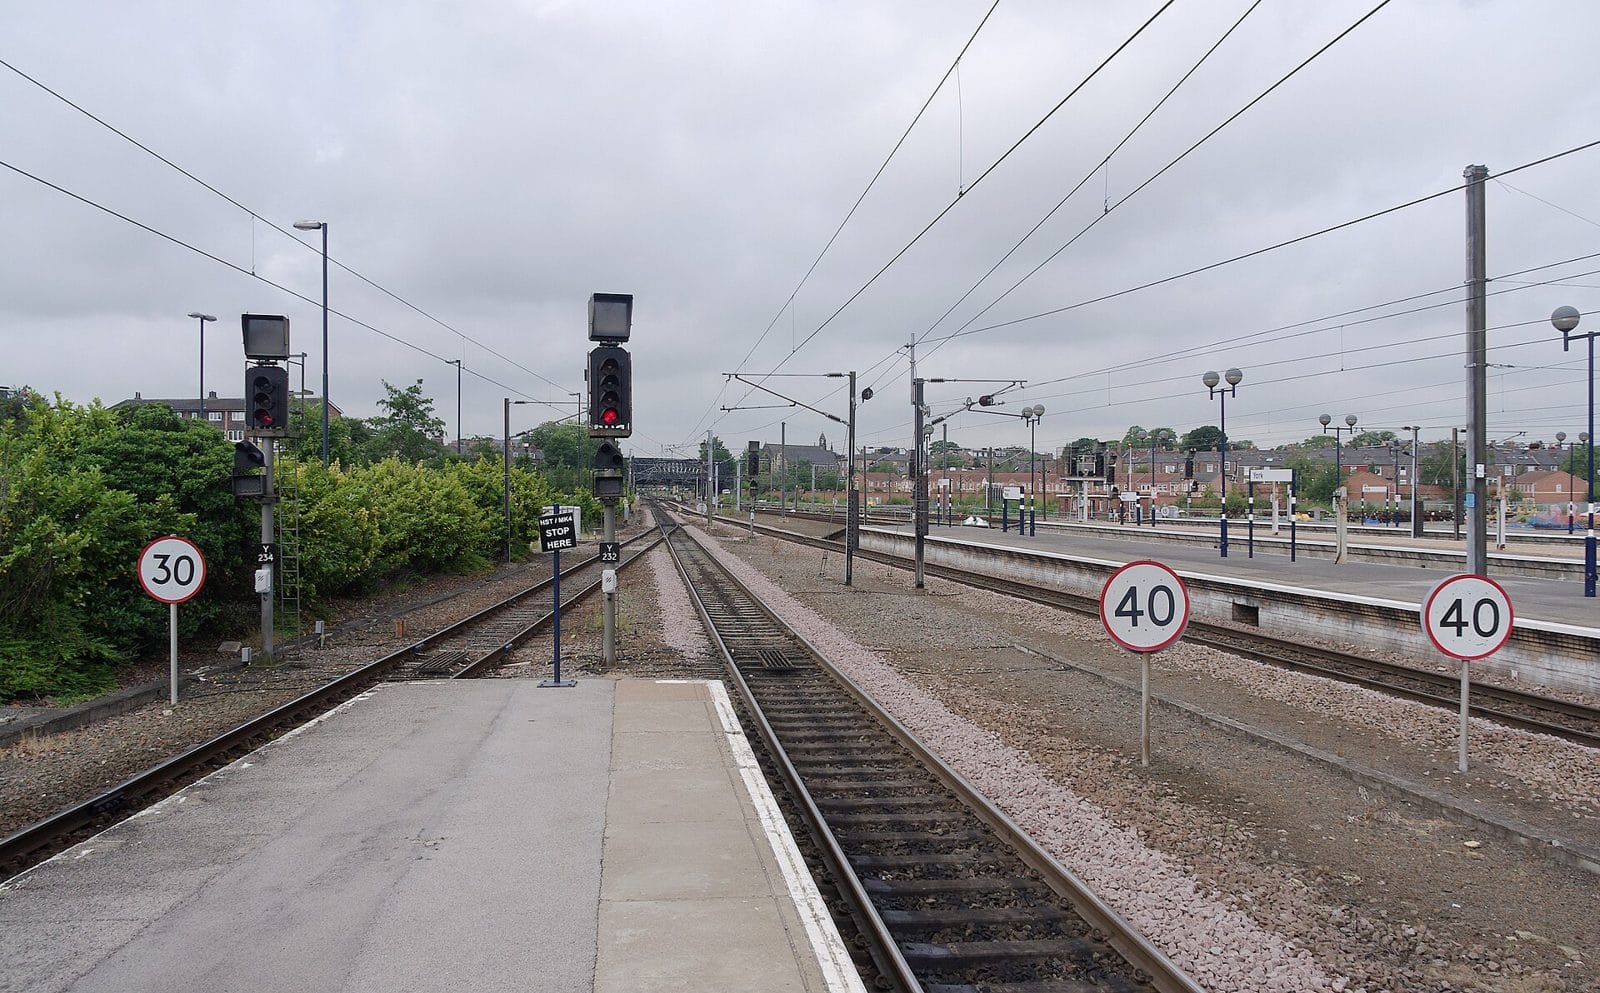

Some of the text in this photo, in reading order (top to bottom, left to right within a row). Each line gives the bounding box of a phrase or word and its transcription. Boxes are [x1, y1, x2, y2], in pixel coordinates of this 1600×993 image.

[540, 518, 553, 526] HST
[545, 527, 570, 537] STOP
[547, 539, 572, 549] HERE
[606, 544, 613, 552] Y
[262, 545, 269, 553] Y
[258, 553, 274, 561] 234
[602, 552, 617, 561] 232
[151, 554, 195, 586] 30
[1114, 584, 1175, 627] 40
[1439, 597, 1500, 638] 40
